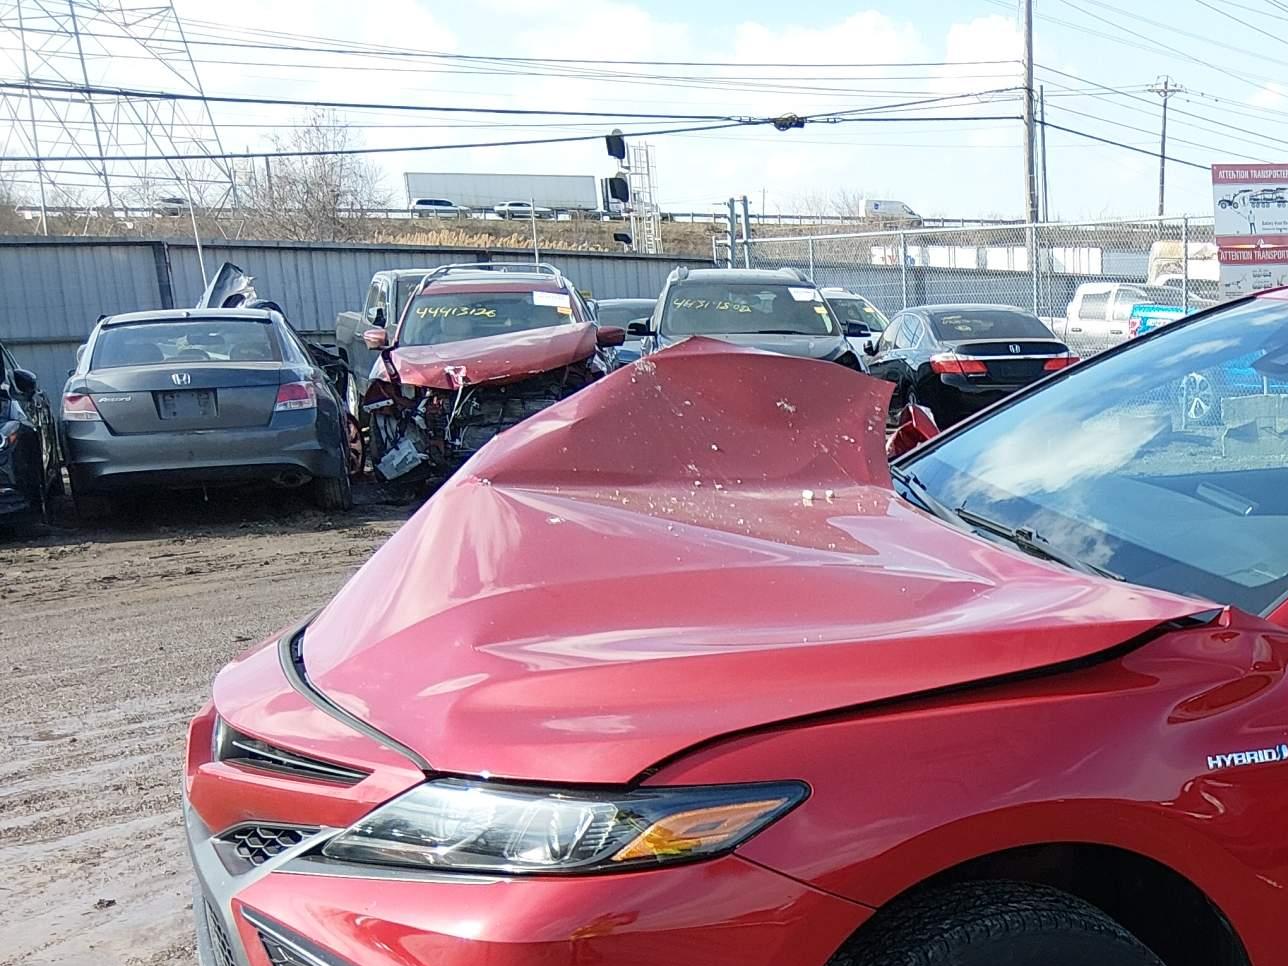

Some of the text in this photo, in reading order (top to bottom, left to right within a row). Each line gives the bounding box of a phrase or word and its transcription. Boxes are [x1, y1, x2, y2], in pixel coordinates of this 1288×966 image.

[1218, 170, 1249, 179] ATTENTION
[1221, 251, 1252, 260] ATTENTION
[1207, 748, 1278, 770] HYBRID
